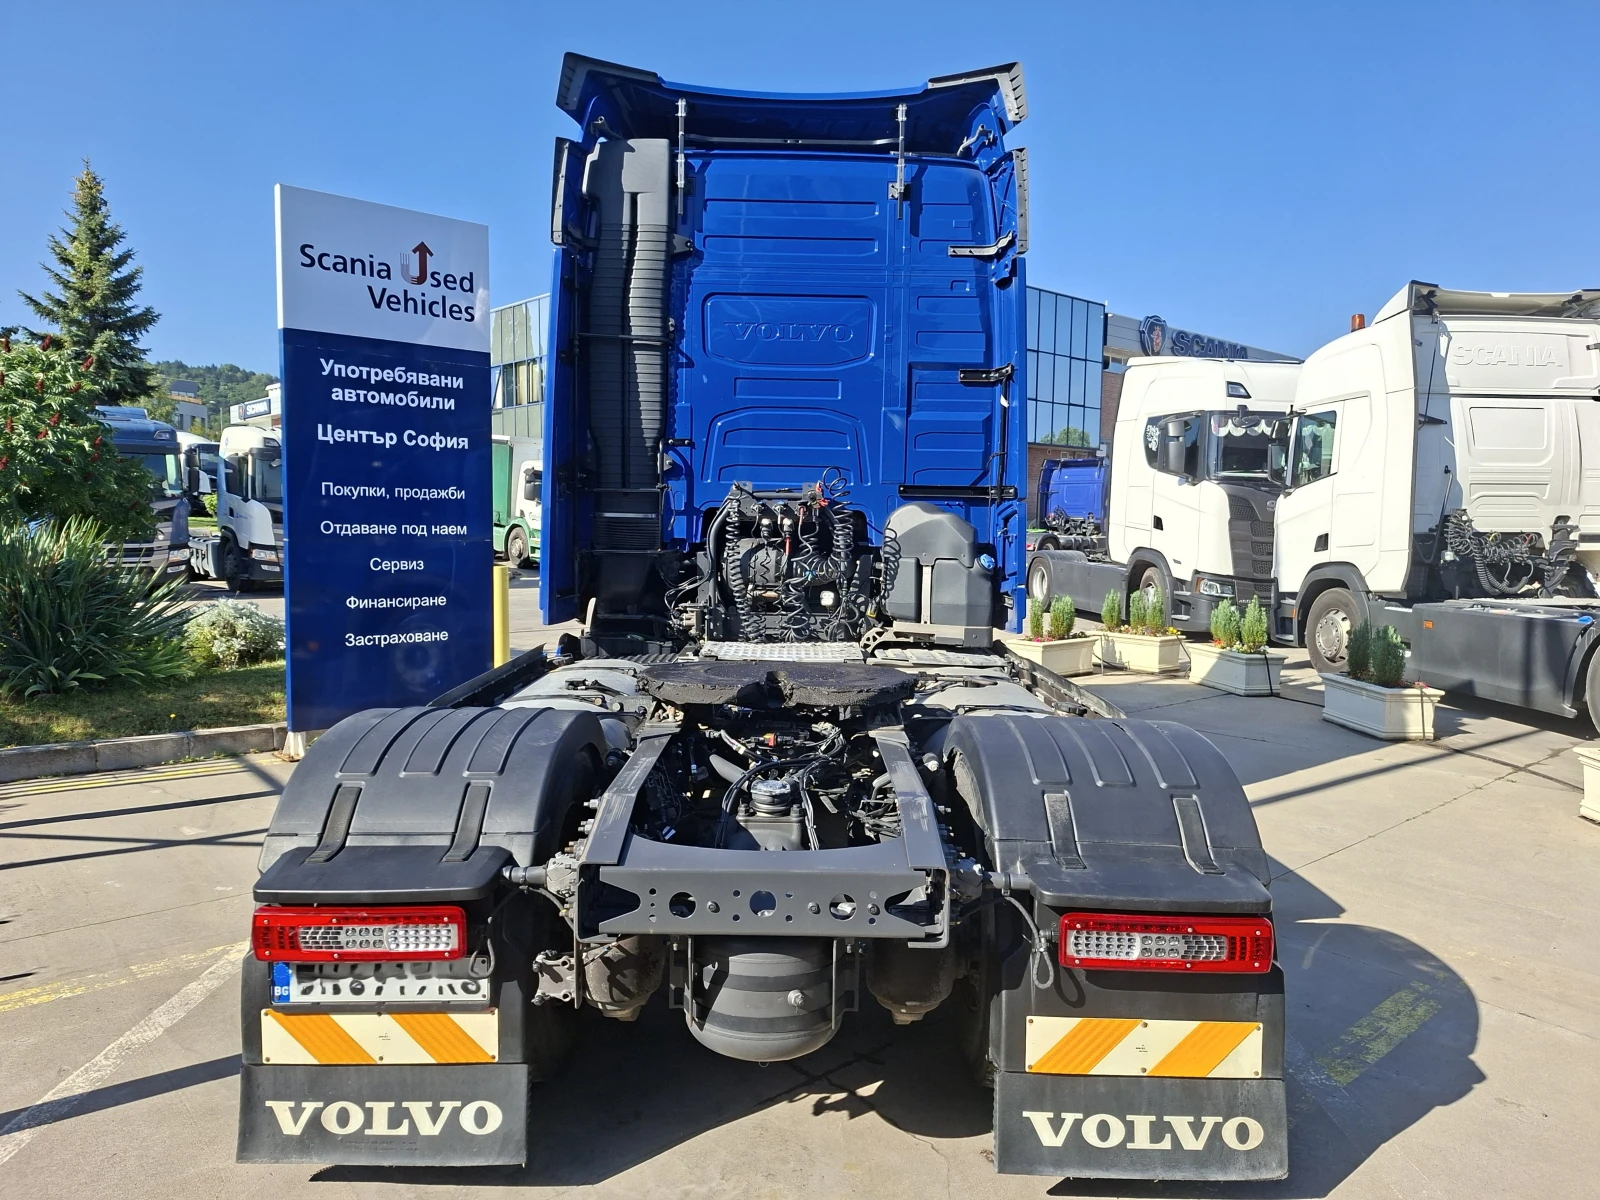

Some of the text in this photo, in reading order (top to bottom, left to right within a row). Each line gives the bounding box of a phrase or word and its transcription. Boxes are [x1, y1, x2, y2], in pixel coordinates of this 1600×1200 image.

[299, 243, 392, 281] Scania
[366, 284, 476, 323] Vehicles
[723, 321, 854, 343] VOLVO
[1171, 329, 1249, 359] SCANIA
[1450, 344, 1564, 367] SCANIA
[319, 358, 464, 390] Употребявани
[331, 386, 456, 411] автомобили
[317, 423, 469, 452] Център София
[321, 481, 466, 501] Покупки, продажби
[320, 520, 467, 537] Отдаване под наем
[369, 557, 425, 573] Сервиз
[345, 595, 447, 610] Финансиране
[344, 630, 449, 647] Застраховане
[274, 986, 289, 996] BG
[265, 1100, 503, 1136] VOLVO
[1022, 1110, 1265, 1151] VOLVO
